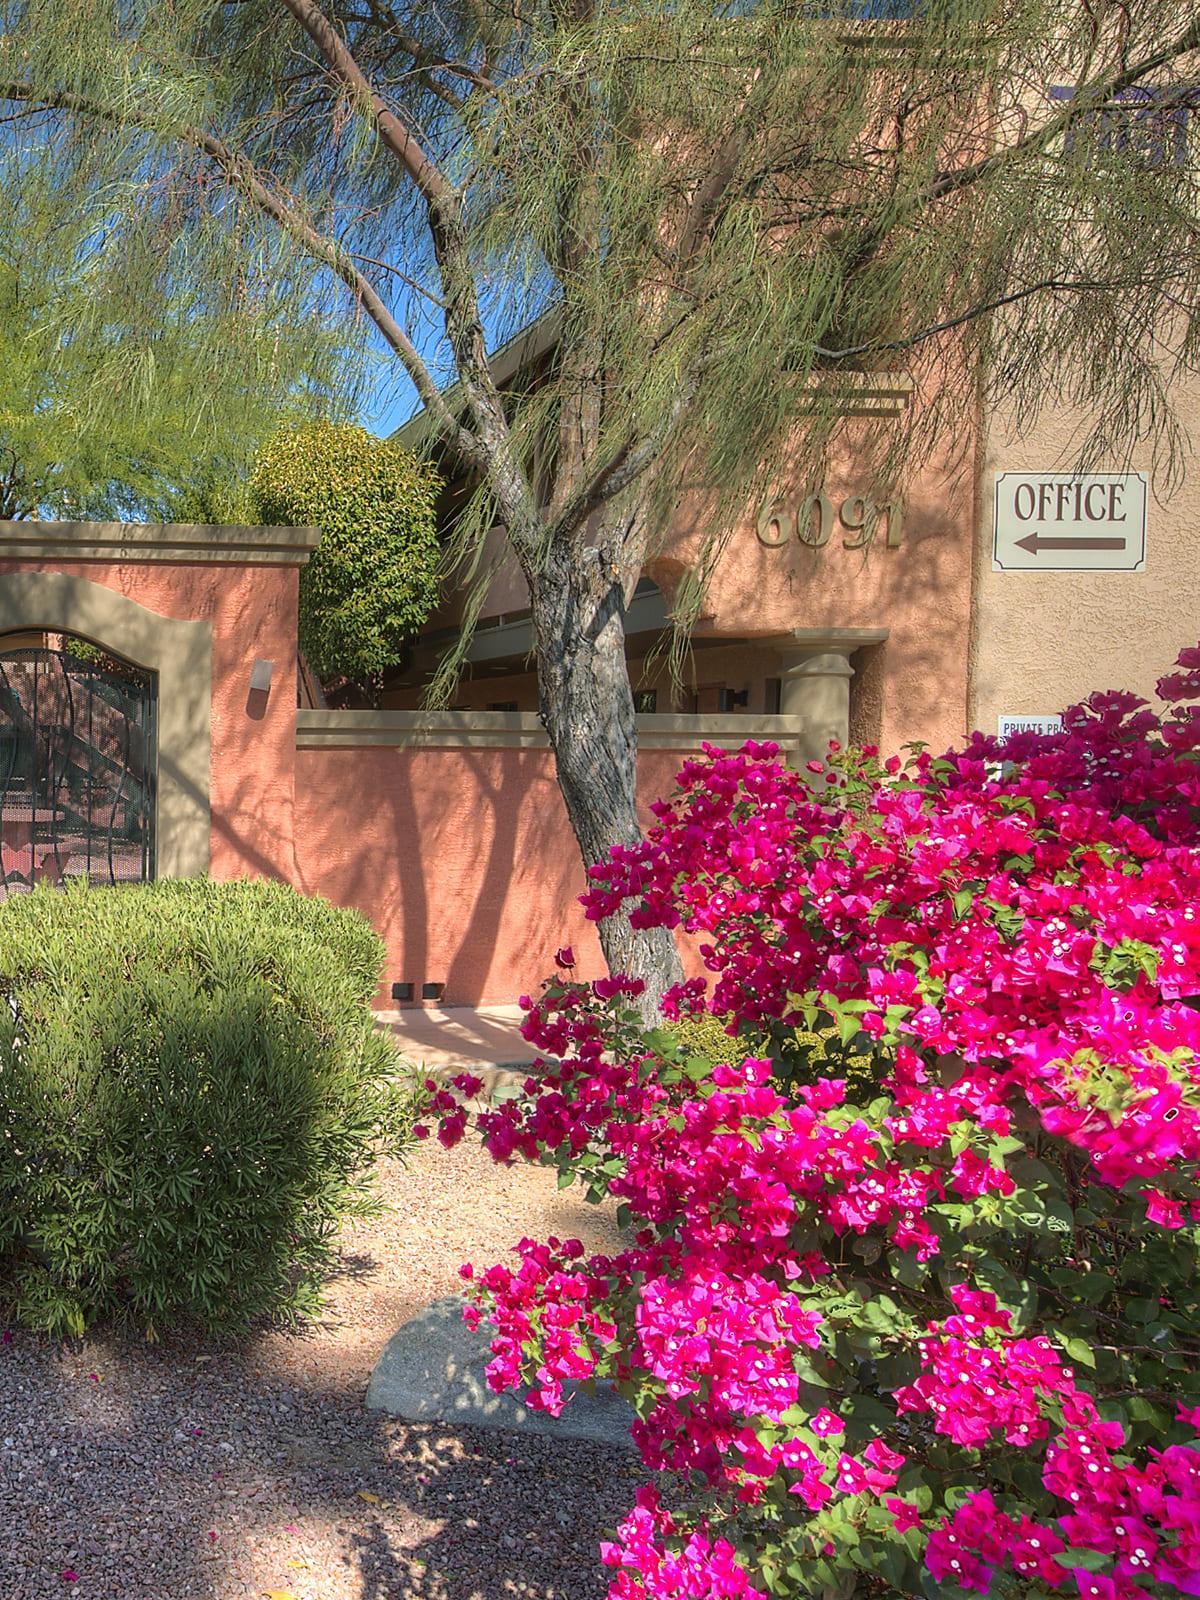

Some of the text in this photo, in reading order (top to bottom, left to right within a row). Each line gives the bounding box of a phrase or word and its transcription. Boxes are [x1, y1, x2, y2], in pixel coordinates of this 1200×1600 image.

[756, 495, 905, 549] 6091
[1014, 482, 1127, 522] OFFICE
[1003, 722, 1043, 736] PRIVATE
